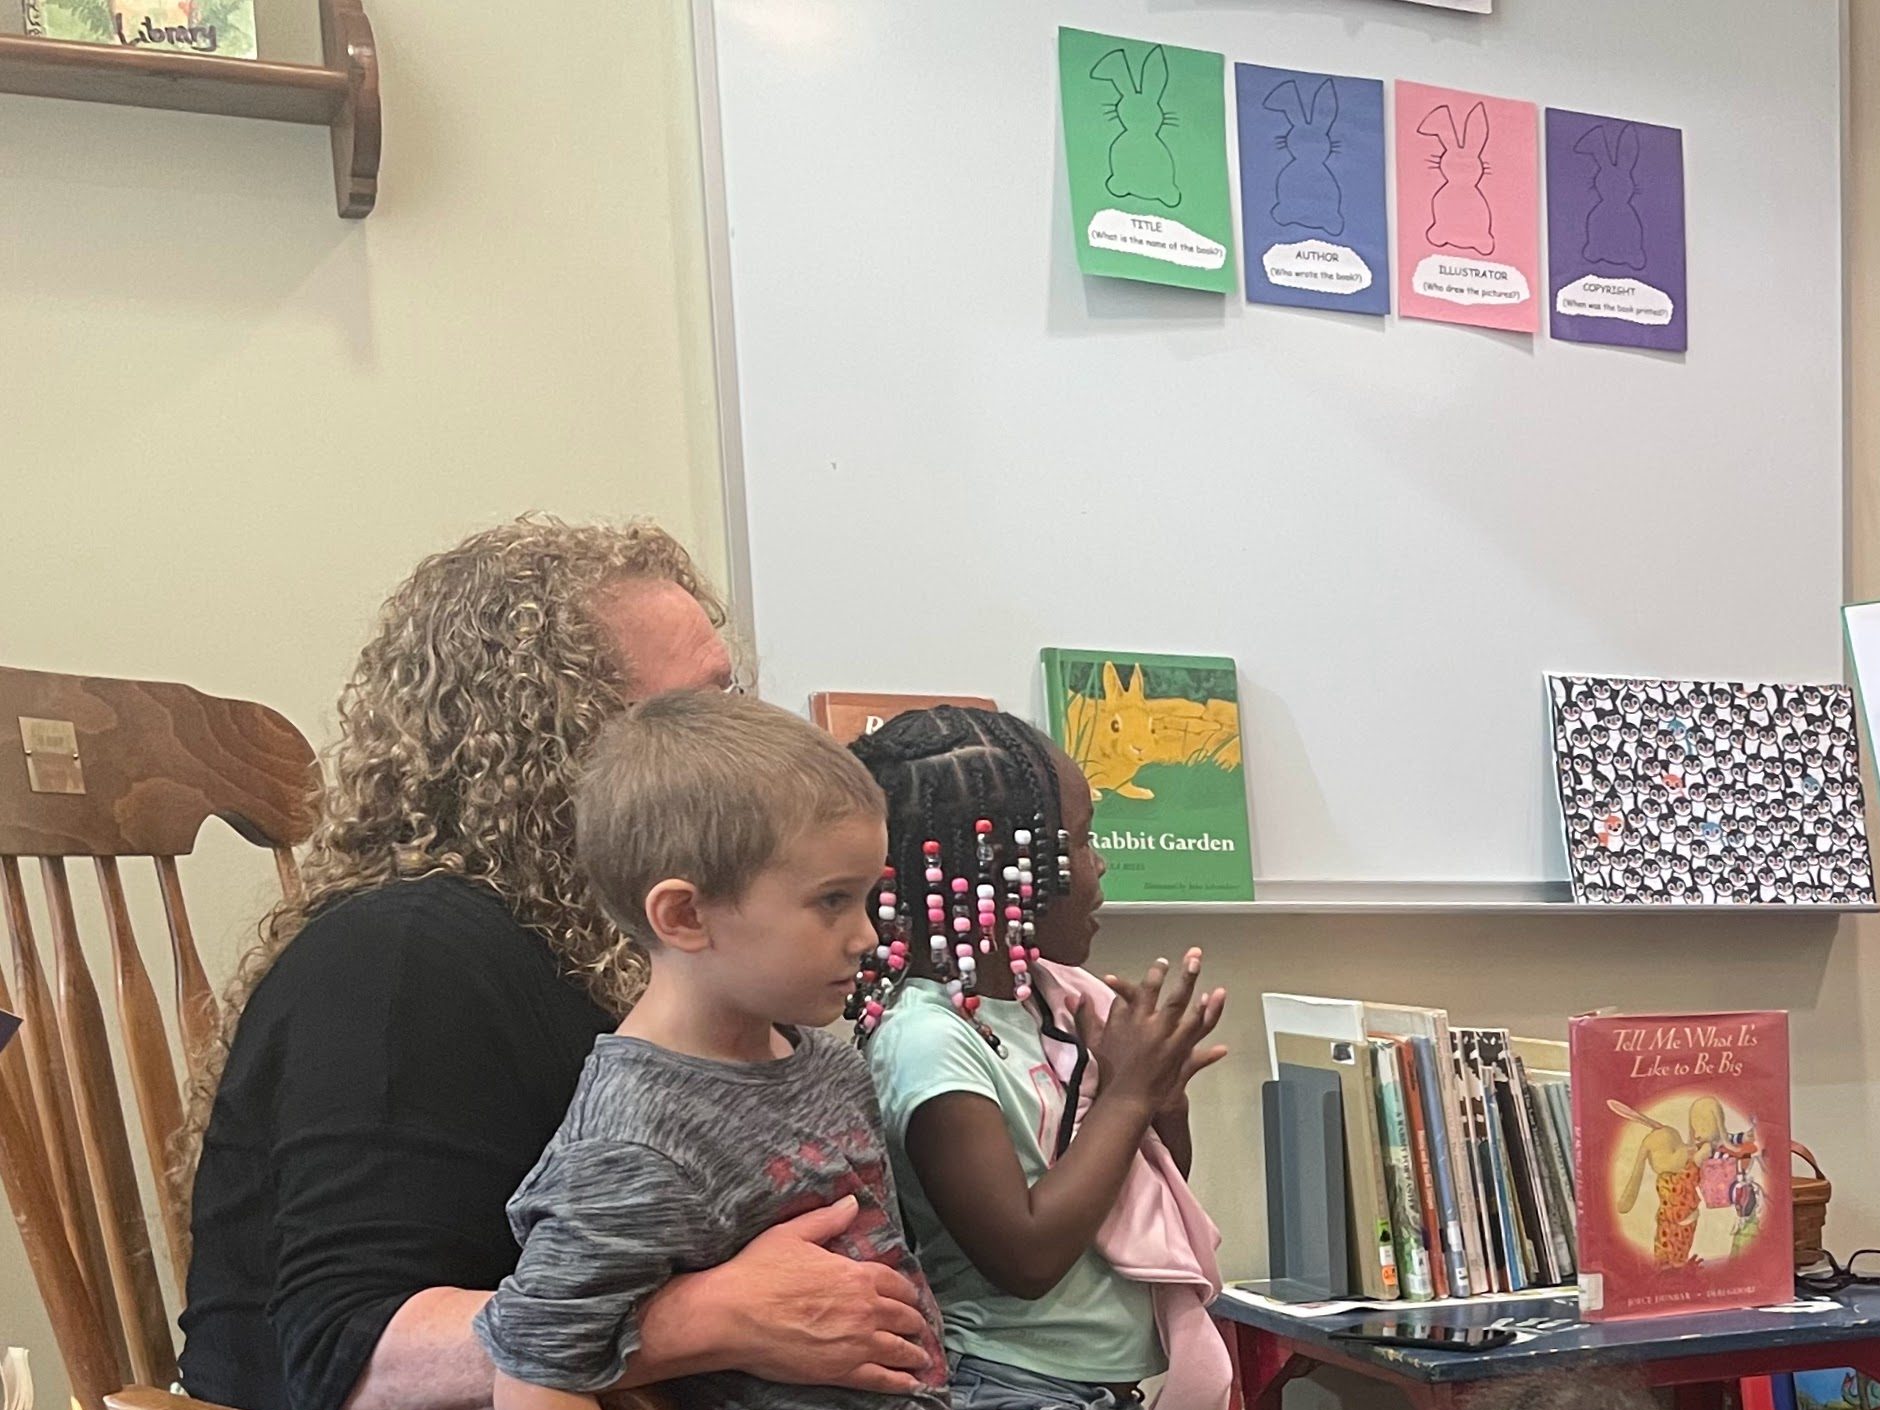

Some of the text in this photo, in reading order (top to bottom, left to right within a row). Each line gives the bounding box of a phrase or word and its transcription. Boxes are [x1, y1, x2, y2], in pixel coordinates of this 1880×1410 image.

[115, 12, 217, 52] Library
[1131, 219, 1163, 232] TITLE
[1120, 234, 1127, 242] is
[1129, 236, 1143, 245] the
[1146, 240, 1166, 249] name
[1168, 241, 1178, 250] of
[1180, 243, 1194, 252] the
[1295, 250, 1339, 262] AUTHOR
[1295, 270, 1317, 279] wrote
[1320, 271, 1334, 280] the
[1439, 265, 1508, 280] ILLUSTRATOR
[1445, 284, 1464, 294] drew
[1467, 286, 1479, 295] the
[1583, 282, 1636, 296] COPYRIGHT
[1603, 303, 1615, 311] the
[1088, 831, 1235, 851] Rabbit Garden
[1613, 1024, 1758, 1051] Tell Me What It's
[1630, 1052, 1743, 1078] Like to Be Big
